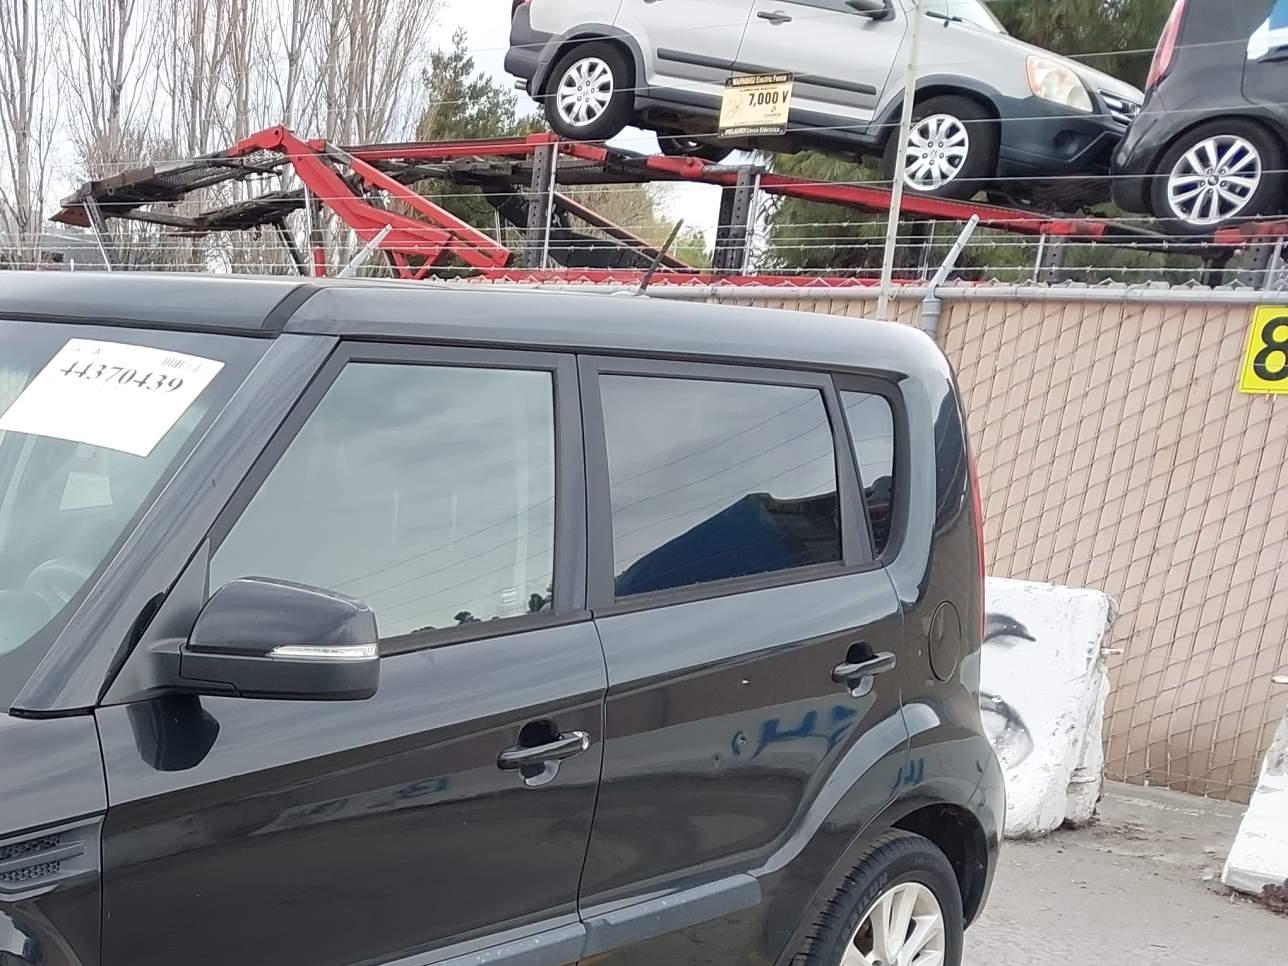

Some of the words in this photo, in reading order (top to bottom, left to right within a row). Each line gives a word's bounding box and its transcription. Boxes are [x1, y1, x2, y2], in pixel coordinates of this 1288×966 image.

[748, 91, 779, 107] 7,000
[782, 90, 789, 103] V
[1253, 316, 1288, 382] 8
[59, 360, 185, 393] 44370439
